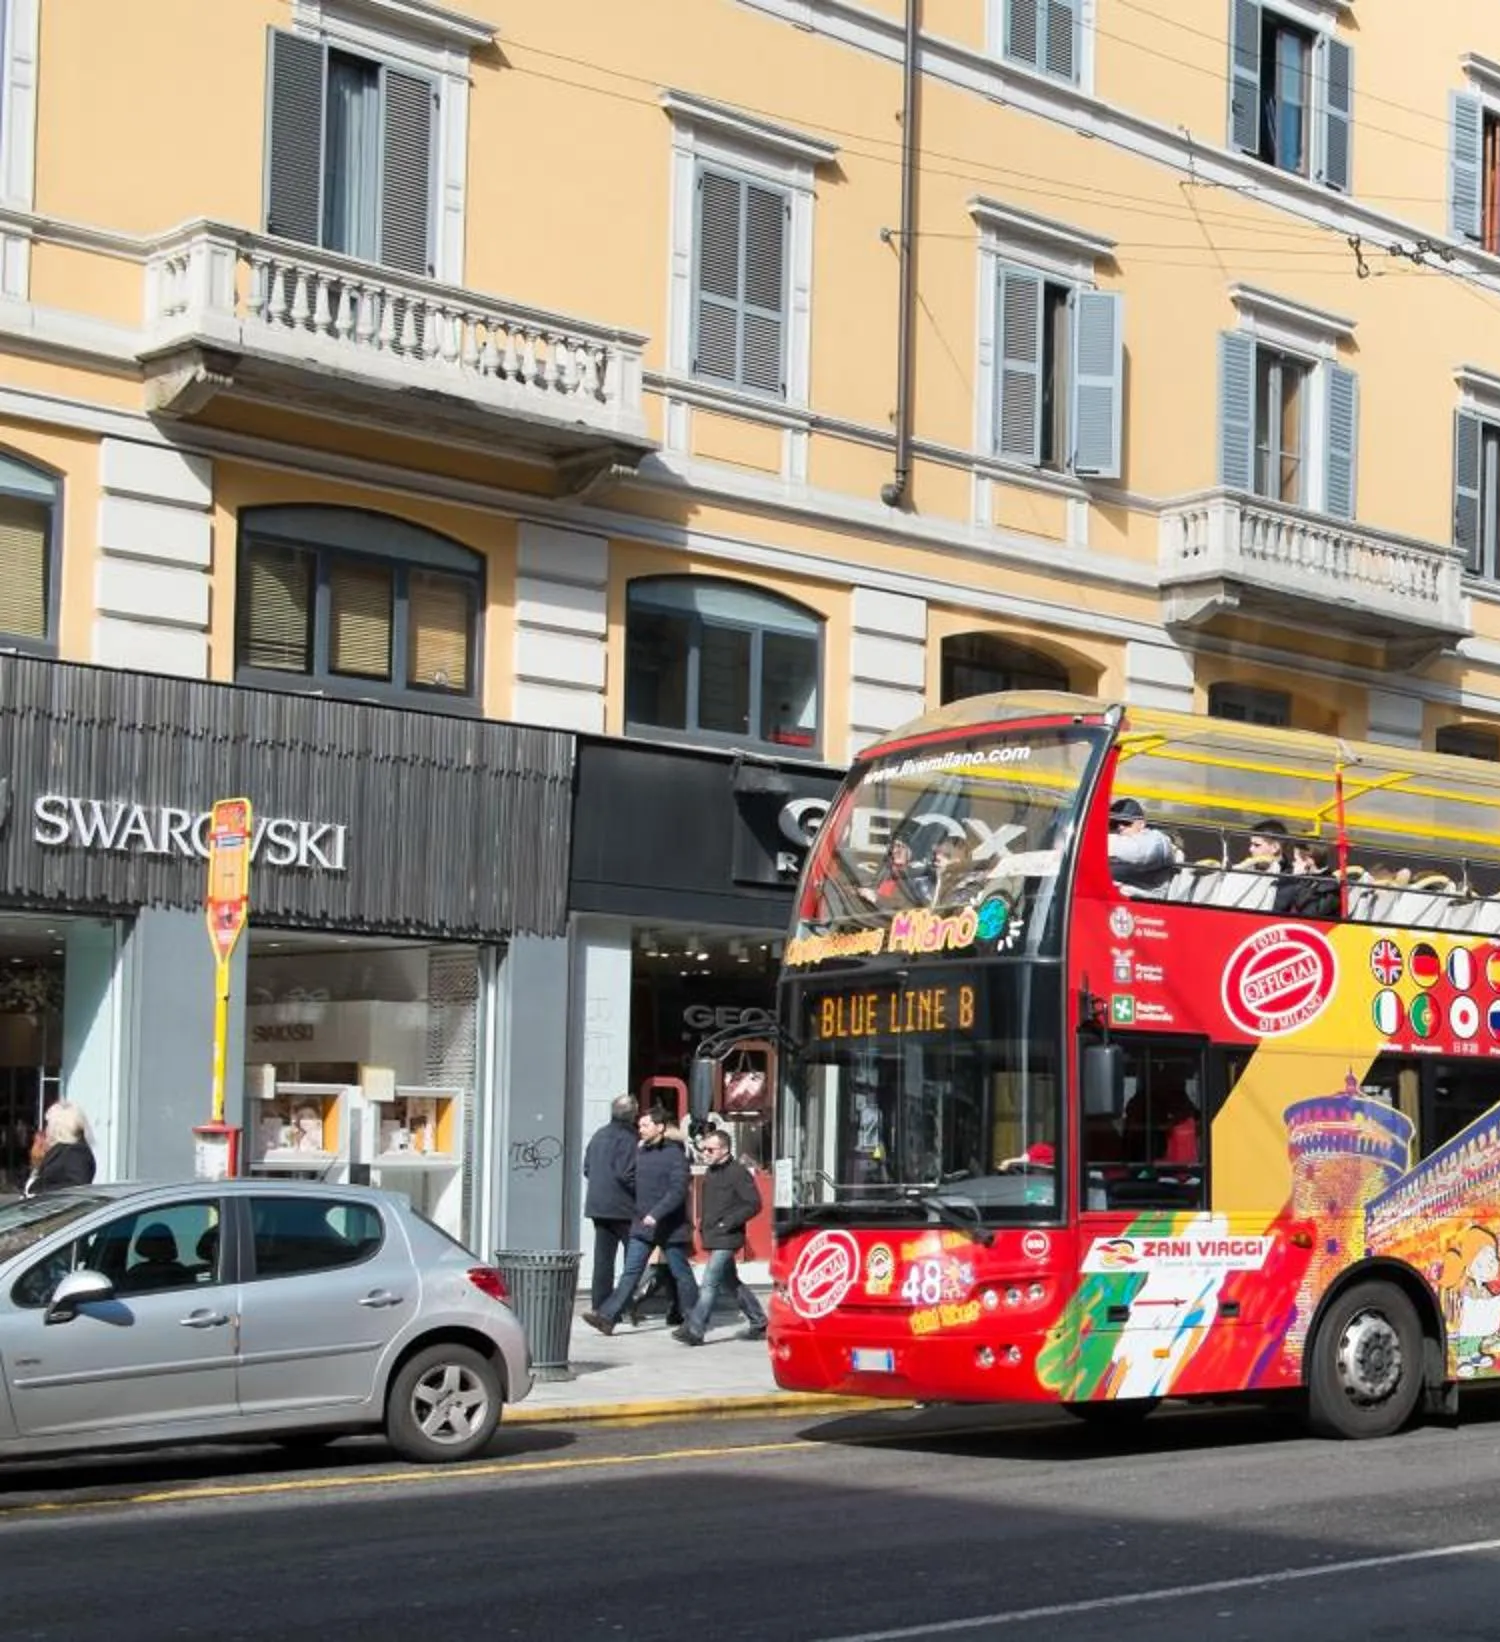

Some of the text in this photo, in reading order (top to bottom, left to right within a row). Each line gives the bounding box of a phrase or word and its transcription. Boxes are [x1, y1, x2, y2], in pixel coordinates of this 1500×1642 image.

[1250, 929, 1290, 953] TOUR
[1245, 953, 1319, 1003] OFFICIAL
[683, 1005, 778, 1029] GEO
[820, 984, 975, 1038] BLUE LINE B
[1142, 1240, 1263, 1257] ZANI VIAGGI
[901, 1260, 941, 1306] 48
